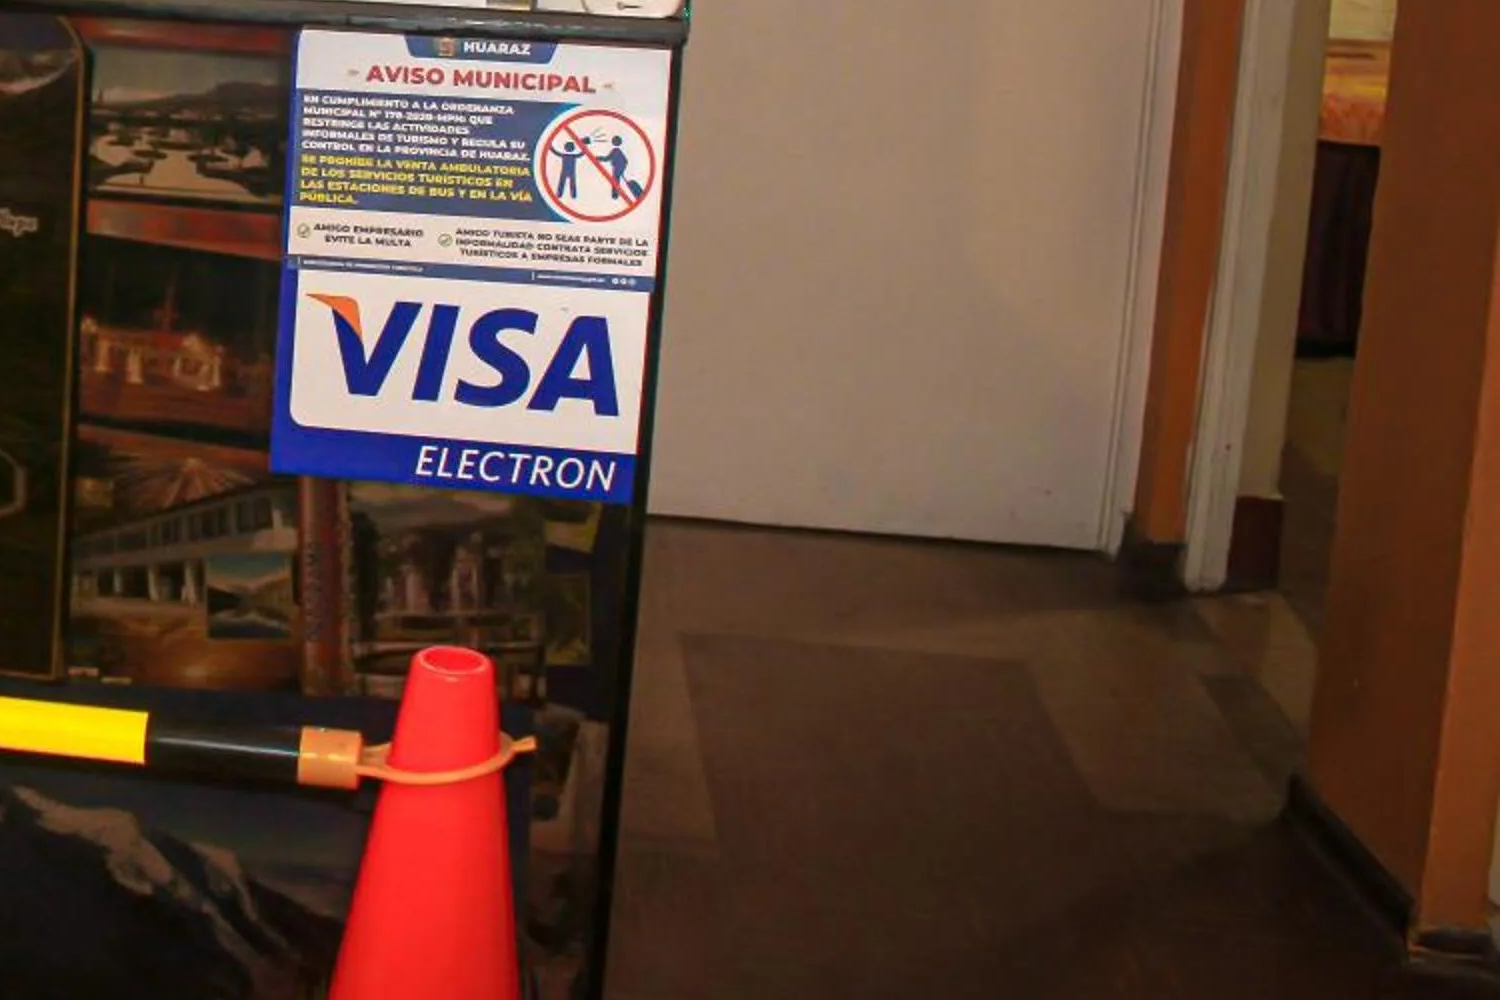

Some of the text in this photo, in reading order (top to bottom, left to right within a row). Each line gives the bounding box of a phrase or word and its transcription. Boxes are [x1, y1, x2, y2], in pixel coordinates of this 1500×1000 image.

[463, 40, 531, 56] HUARAZ
[366, 64, 597, 93] AVISO MUNICIPAL
[303, 95, 319, 104] EN
[322, 96, 409, 109] CUMPLIMIENTO
[411, 101, 420, 110] A
[423, 101, 438, 110] LA
[304, 107, 366, 117] MUNICIPAL
[469, 115, 493, 125] QUE
[303, 117, 470, 135] RESTRINGE LAS ACTIVIDADES
[303, 129, 375, 141] INFORMALES
[378, 133, 393, 142] DE
[396, 133, 448, 145] TURISMO
[452, 138, 460, 146] Y
[510, 141, 526, 149] SU
[301, 140, 355, 151] CONTROL
[377, 145, 392, 153] LA
[394, 146, 458, 157] PROVINCIA
[461, 150, 477, 159] DE
[301, 167, 318, 176] DE
[321, 167, 346, 177] LOS
[349, 169, 415, 182] SERVICIOS
[377, 159, 392, 168] LA
[396, 159, 437, 171] VENTA
[442, 163, 531, 176] AMBULATORIA
[300, 179, 325, 189] LAS
[327, 181, 405, 194] ESTACIONES
[408, 186, 426, 196] DE
[429, 187, 455, 198] BUS
[458, 189, 466, 198] Y
[469, 189, 486, 199] EN
[489, 191, 507, 200] LA
[313, 222, 424, 237] AMIGO EMPRESARIO
[455, 227, 649, 247] AMIGO TURISTA NO SEAS PARTE DE LA
[324, 235, 412, 247] EVITE LA MULTA
[537, 242, 591, 254] CONTRATA
[594, 246, 648, 257] SERVICIOS
[531, 253, 585, 264] EMPRESAS
[587, 256, 643, 267] FORMALES
[305, 293, 620, 417] VISA
[415, 445, 616, 493] ELECTRON
